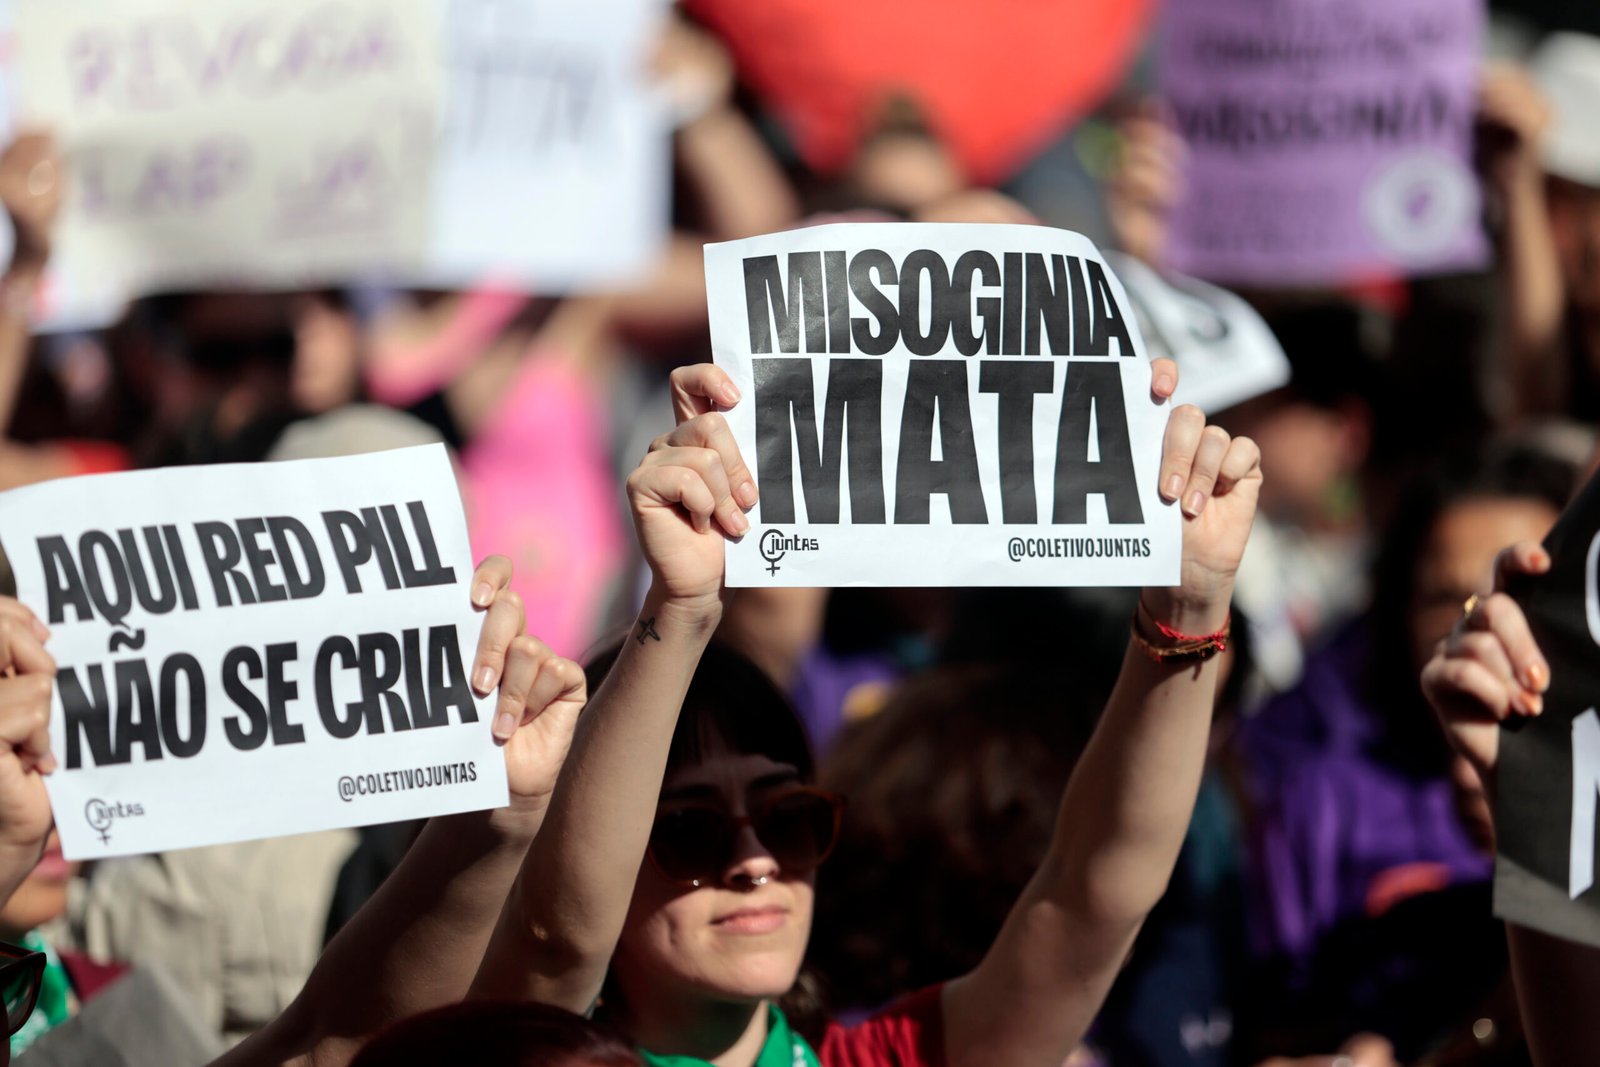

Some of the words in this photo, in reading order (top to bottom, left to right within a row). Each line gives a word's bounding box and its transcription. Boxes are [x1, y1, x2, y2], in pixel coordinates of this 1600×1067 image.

[743, 249, 1136, 358] MISOGINIA
[751, 358, 1145, 525] MATA
[36, 524, 200, 628] AQUI
[193, 515, 325, 608] RED
[321, 501, 457, 594] PILL
[1008, 537, 1151, 562] @COLETIVOJUNTAS
[56, 629, 207, 769] NÃO
[222, 642, 307, 751] SE
[314, 624, 479, 740] CRIA
[338, 761, 478, 802] @COLETIVOJUNTAS
